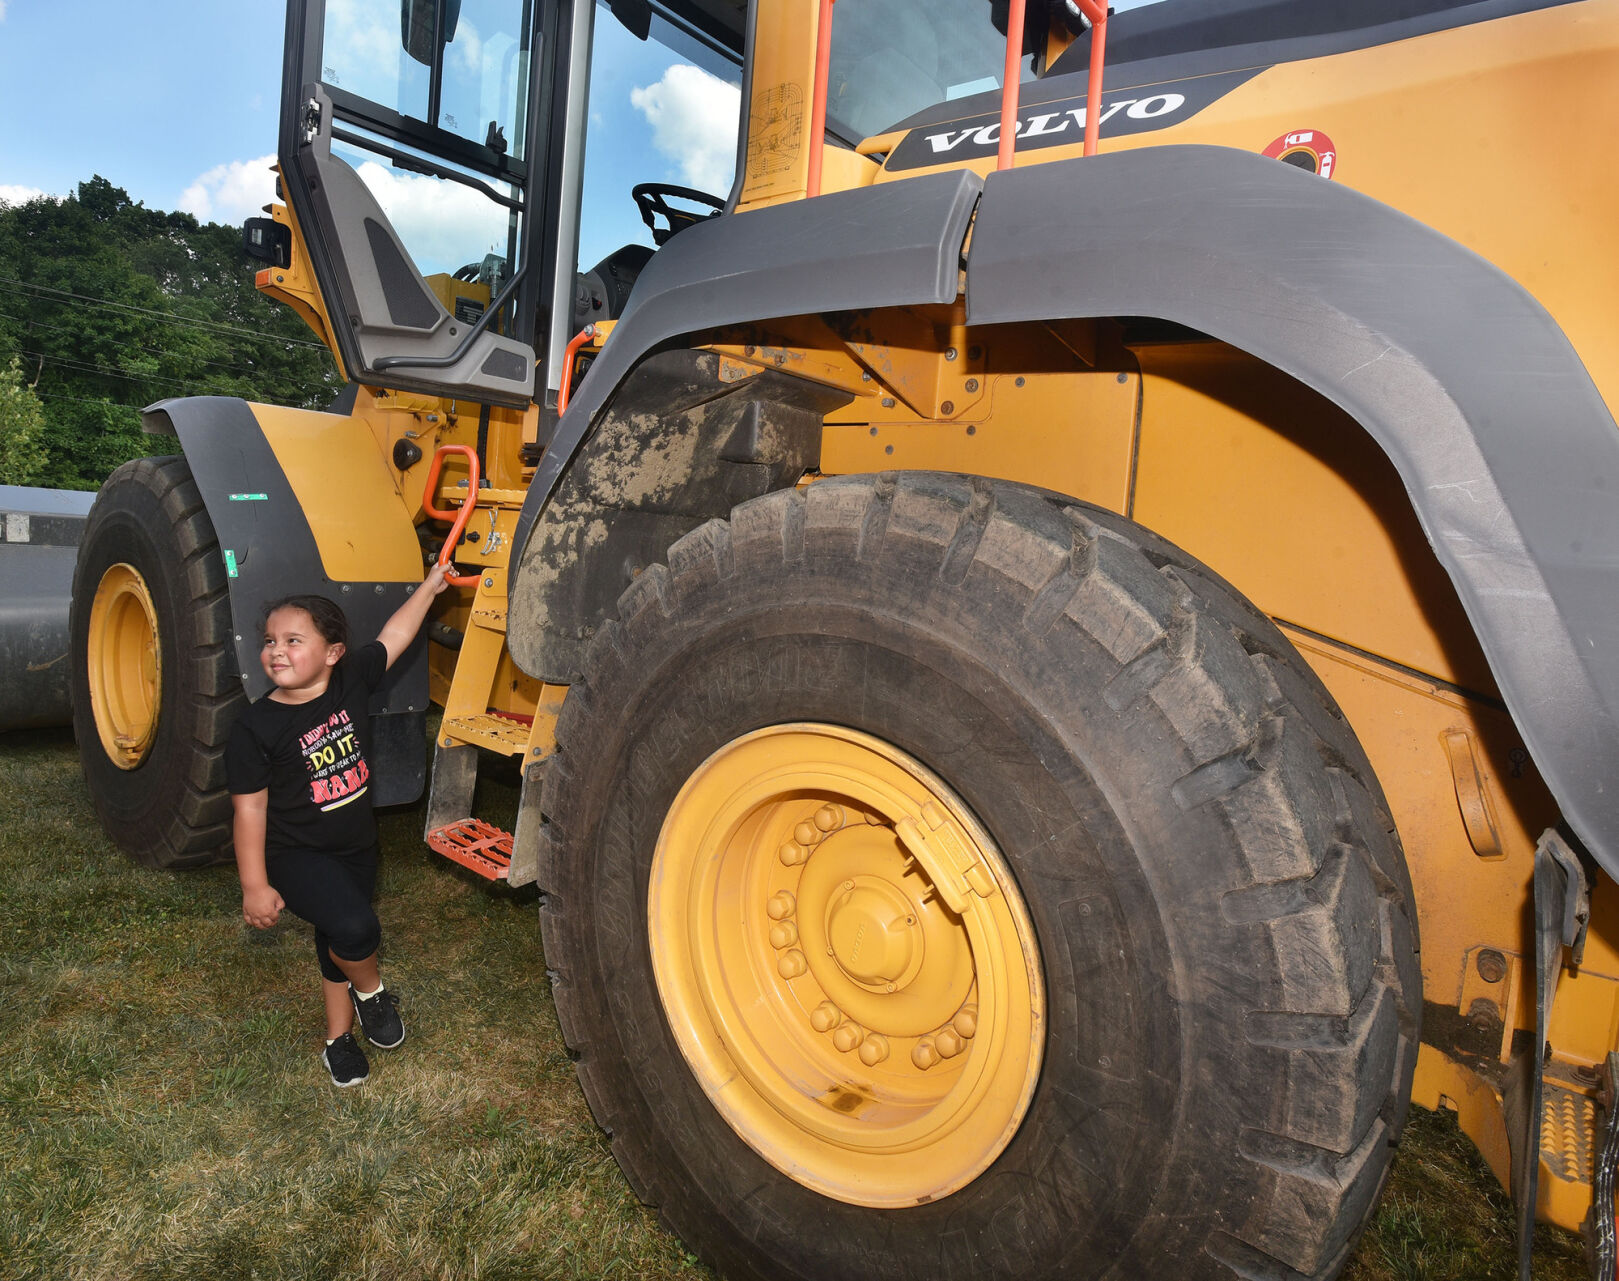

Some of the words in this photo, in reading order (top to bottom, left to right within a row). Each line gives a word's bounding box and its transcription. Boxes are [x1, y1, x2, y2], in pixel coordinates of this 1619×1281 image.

[925, 94, 1185, 152] VOLVO
[339, 709, 350, 724] IT
[327, 729, 342, 741] SAW
[309, 745, 335, 771] DO
[337, 733, 354, 757] IT
[328, 765, 336, 773] TO
[349, 754, 357, 762] TO
[310, 760, 369, 804] NANA
